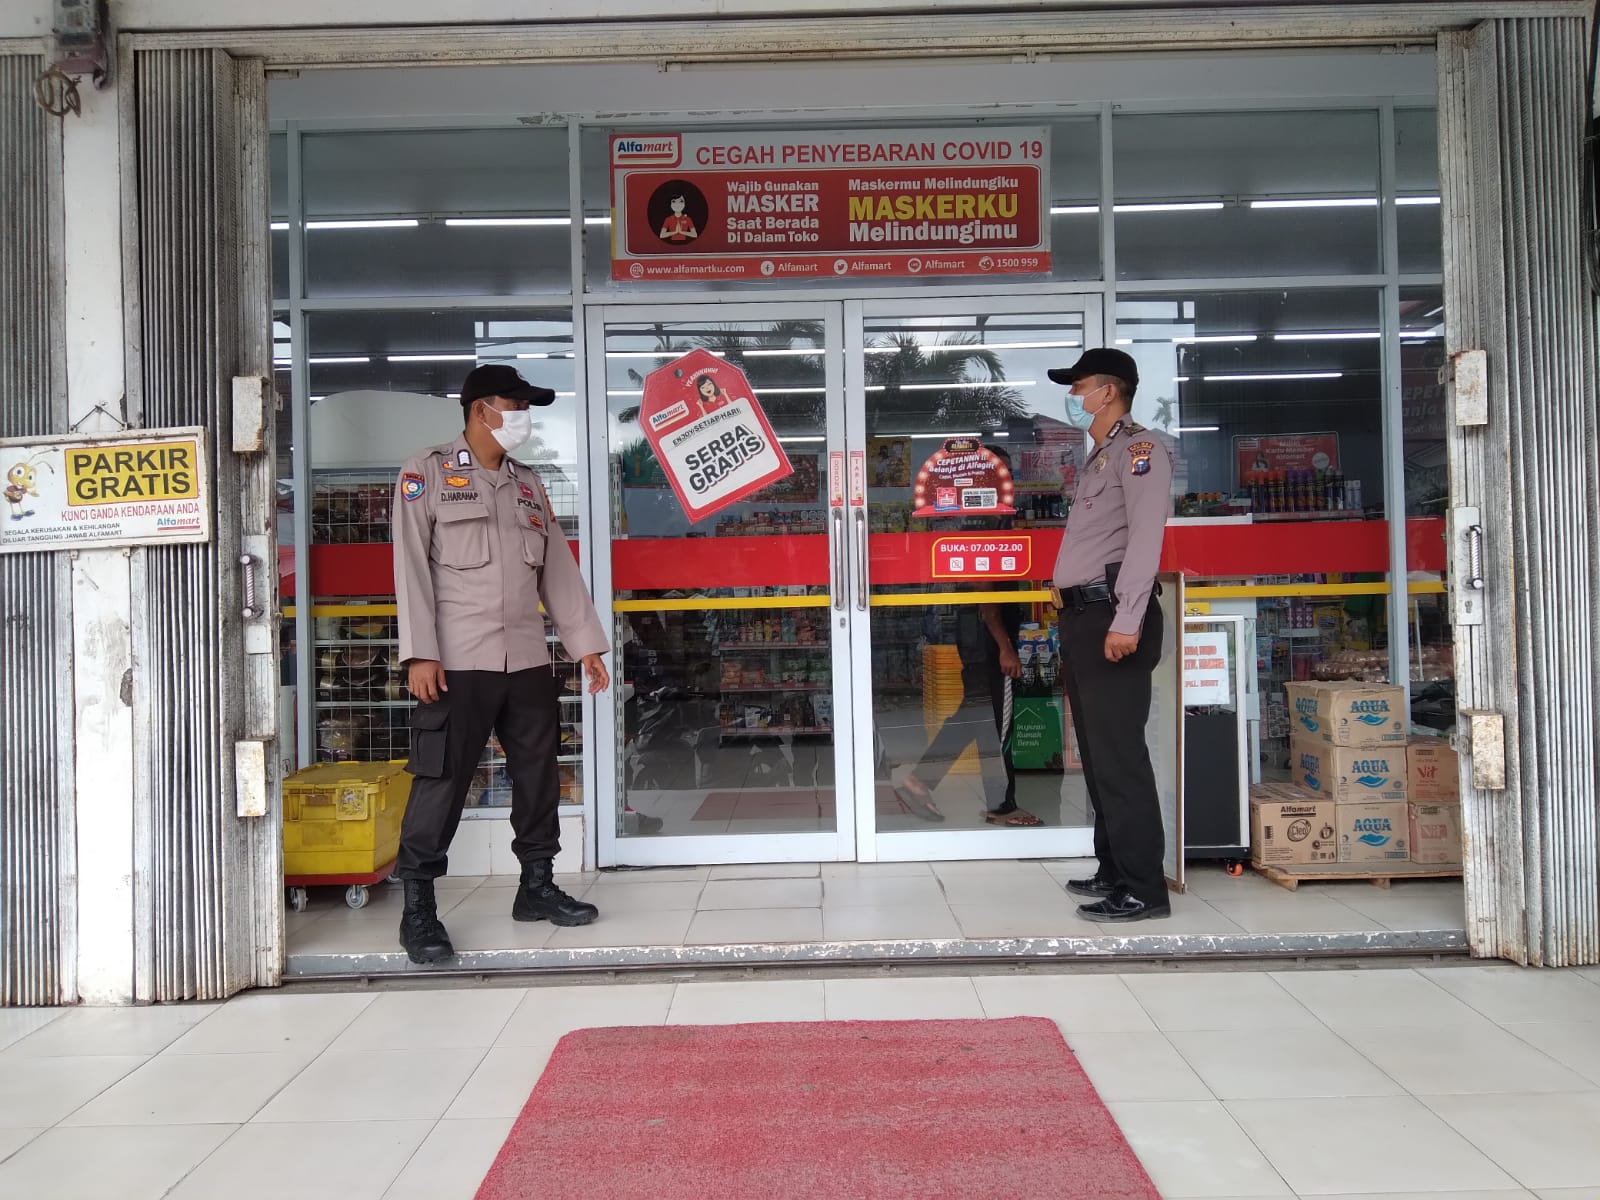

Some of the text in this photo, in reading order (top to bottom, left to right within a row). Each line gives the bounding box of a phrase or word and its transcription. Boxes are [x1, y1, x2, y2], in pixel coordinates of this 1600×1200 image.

[617, 141, 673, 153] Alfamart
[696, 140, 1043, 165] CEGAH PENYEBARAN COVID 19
[727, 180, 819, 194] Wajib Gunakan
[848, 176, 1019, 191] Maskermu Melindungiku
[727, 193, 819, 213] MASKER
[848, 193, 1018, 221] MASKERKU
[727, 216, 820, 230] Saat Berada
[727, 231, 819, 243] Di Dalam Toko
[849, 220, 1018, 245] Melindungimu
[647, 262, 745, 275] www.alfamartku.com
[778, 262, 818, 272] Alfamart
[851, 261, 892, 271] Alfamart
[925, 260, 965, 270] Alfamart
[997, 258, 1039, 268] 1500 959
[652, 403, 684, 424] Alfamart
[685, 425, 751, 471] SERBA
[73, 448, 190, 475] PARKIR
[689, 436, 764, 492] GRATIS
[928, 461, 995, 475] Belanja di Alfagift
[75, 471, 191, 500] GRATIS
[440, 491, 479, 502] D.HARAHAP
[61, 502, 200, 522] KUNCI GANDA KENDARAAN ANDA
[156, 516, 200, 526] Alfamart
[4, 528, 30, 536] SEGALA
[30, 525, 71, 534] KERUSAKAN
[79, 522, 120, 531] KEHILANGAN
[27, 533, 64, 542] TANGGUNG
[65, 532, 87, 540] JAWAB
[89, 529, 122, 538] ALFAMART
[940, 542, 1023, 553] BUKA: 07.00-22.00
[1350, 699, 1390, 714] AQUA
[1351, 759, 1390, 775] AQUA
[1417, 766, 1438, 778] Vit
[1280, 805, 1316, 813] Alfamart
[1291, 825, 1307, 835] Cleo
[1353, 817, 1392, 834] AQUA
